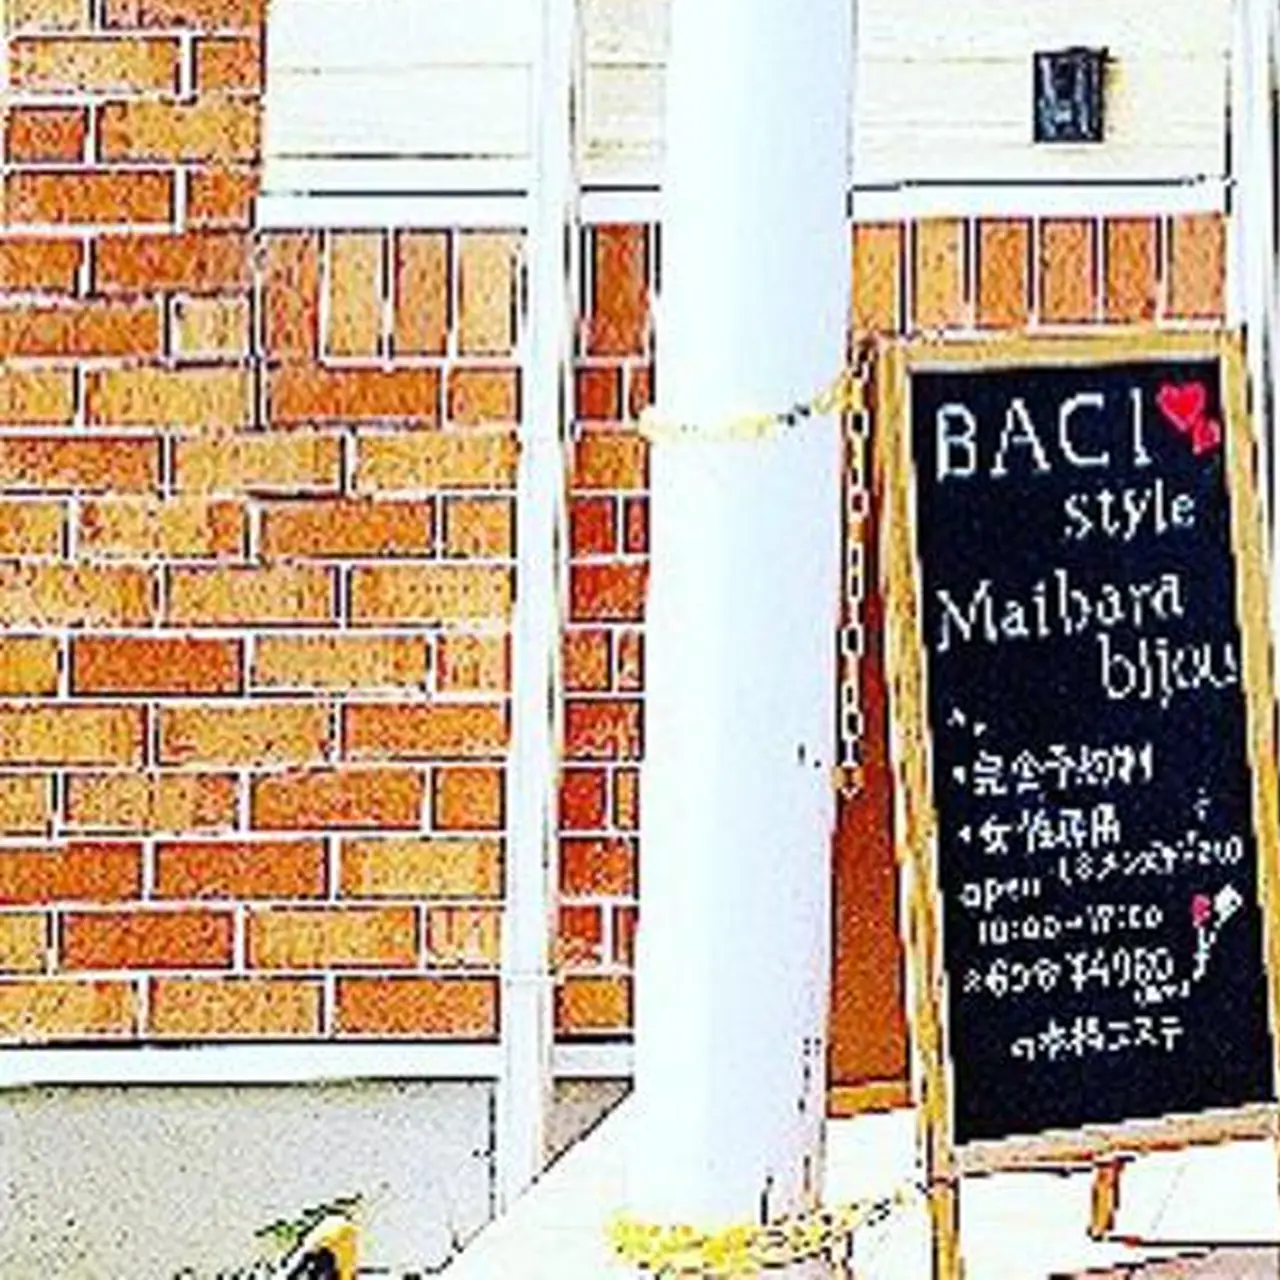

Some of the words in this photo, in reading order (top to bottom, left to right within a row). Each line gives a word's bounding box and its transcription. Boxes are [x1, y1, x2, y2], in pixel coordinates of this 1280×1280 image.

[936, 386, 1152, 482] BACI
[1063, 478, 1195, 541] style
[936, 568, 1185, 655] Maibara
[1096, 632, 1238, 708] bijou
[958, 877, 1041, 912] open
